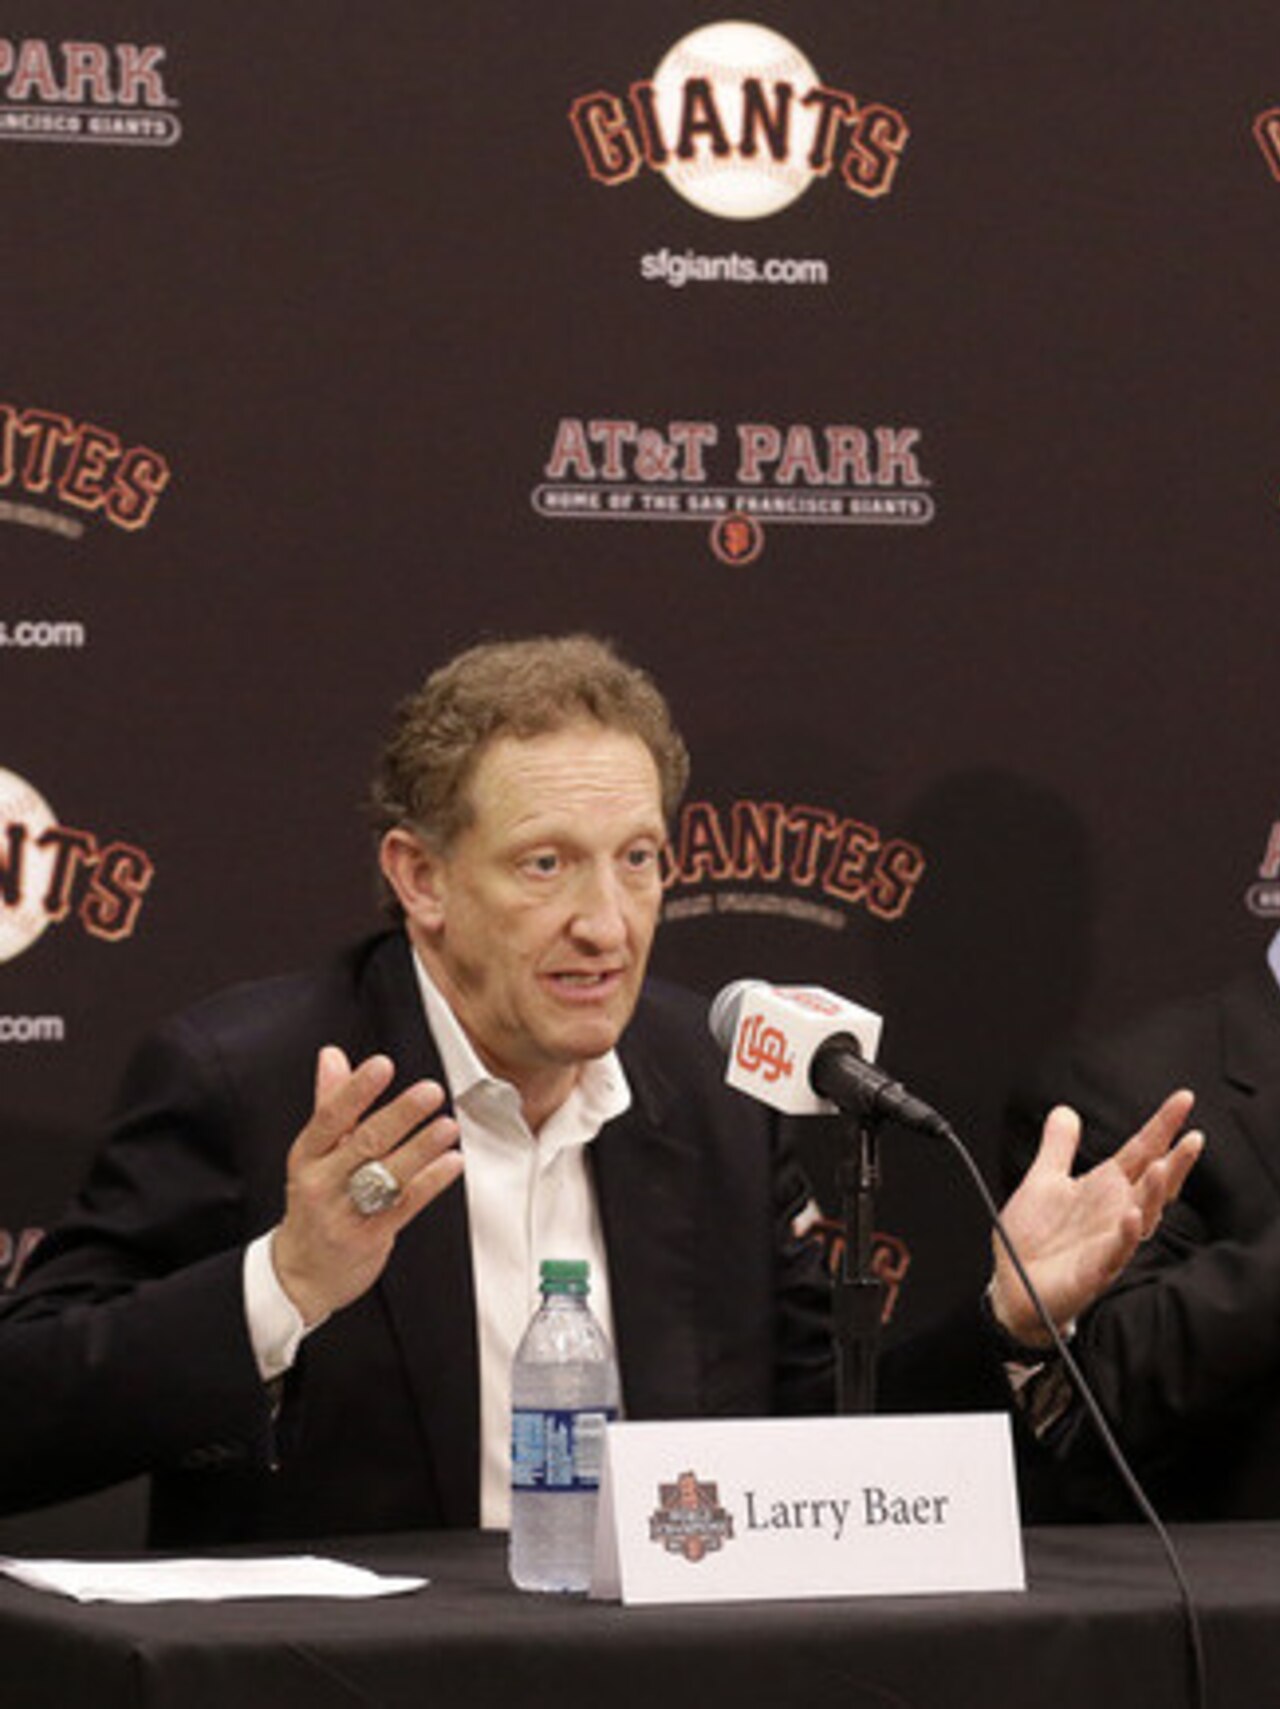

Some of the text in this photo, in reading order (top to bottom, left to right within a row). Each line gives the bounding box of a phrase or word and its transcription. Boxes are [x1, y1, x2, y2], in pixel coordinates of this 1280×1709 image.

[0, 38, 167, 107] ARK
[89, 116, 167, 137] GIANTS
[568, 75, 911, 199] GIANTS
[640, 248, 829, 288] sfgiants.com
[545, 418, 923, 487] AT&T PARK
[544, 490, 922, 517] HOME OF THE SAN FRANCISCO GIANTS
[744, 1491, 850, 1541] Larry
[862, 1487, 949, 1527] Baer
